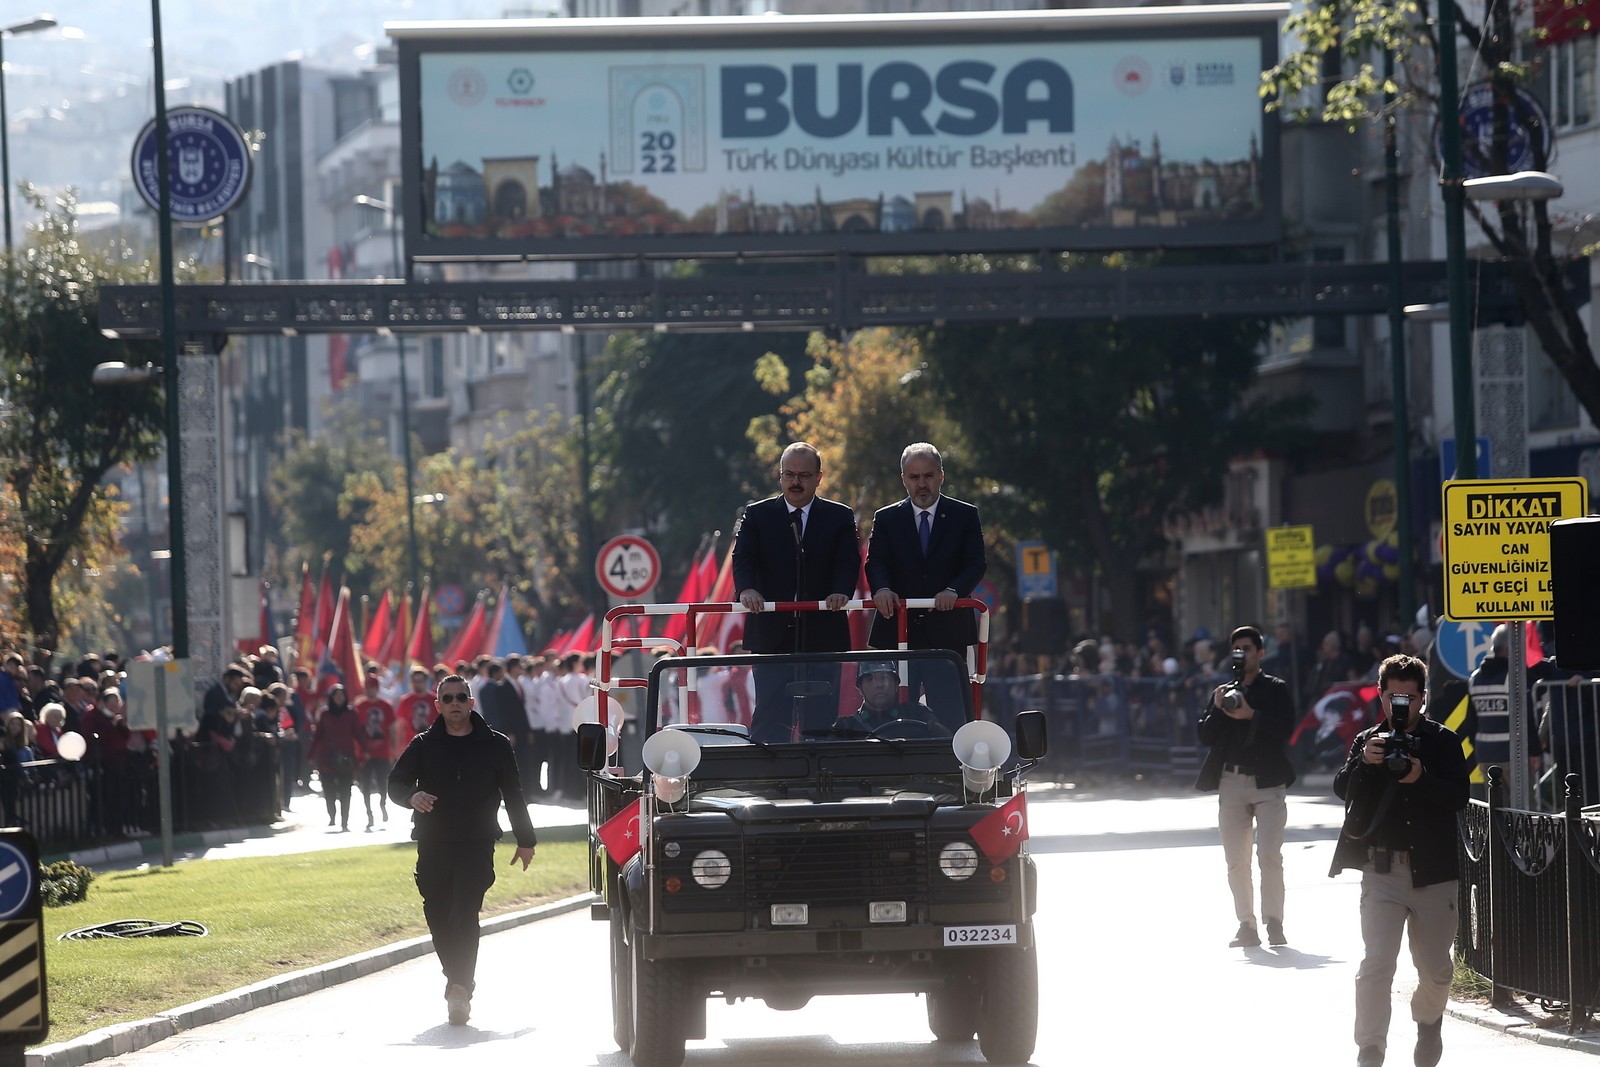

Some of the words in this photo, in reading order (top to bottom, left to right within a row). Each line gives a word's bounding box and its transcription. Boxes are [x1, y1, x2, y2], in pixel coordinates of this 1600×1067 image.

[721, 58, 1074, 139] BURSA
[641, 131, 676, 151] 20
[641, 153, 676, 173] 22
[722, 147, 778, 171] Türk
[784, 146, 880, 177] Dünyası
[886, 144, 963, 170] Kültür
[970, 142, 1076, 175] Başkenti
[1471, 494, 1557, 518] DİKKAT
[1453, 522, 1500, 537] SAYIN
[1501, 543, 1529, 555] CAN
[610, 553, 627, 580] 4
[1451, 559, 1548, 575] GÜVENLİĞİNİZ
[1462, 581, 1489, 594] ALT
[948, 928, 1012, 942] 032234
